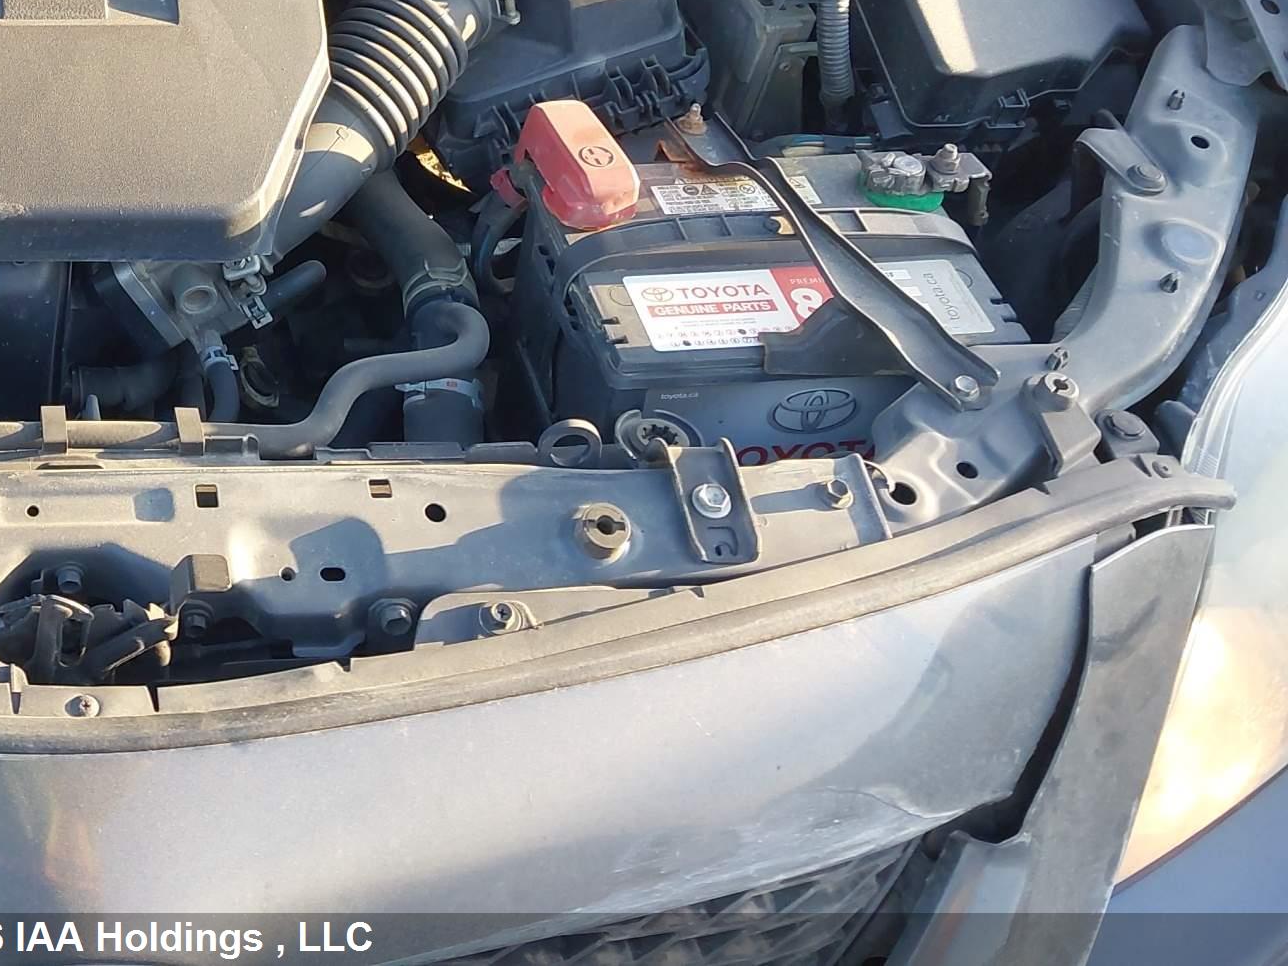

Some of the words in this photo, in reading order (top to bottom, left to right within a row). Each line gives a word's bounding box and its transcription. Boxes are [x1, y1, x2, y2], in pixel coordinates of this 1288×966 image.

[676, 283, 770, 300] TOYOTA
[654, 304, 719, 316] GENUINE
[723, 300, 772, 313] PARTS
[660, 392, 699, 400] toyota.ca
